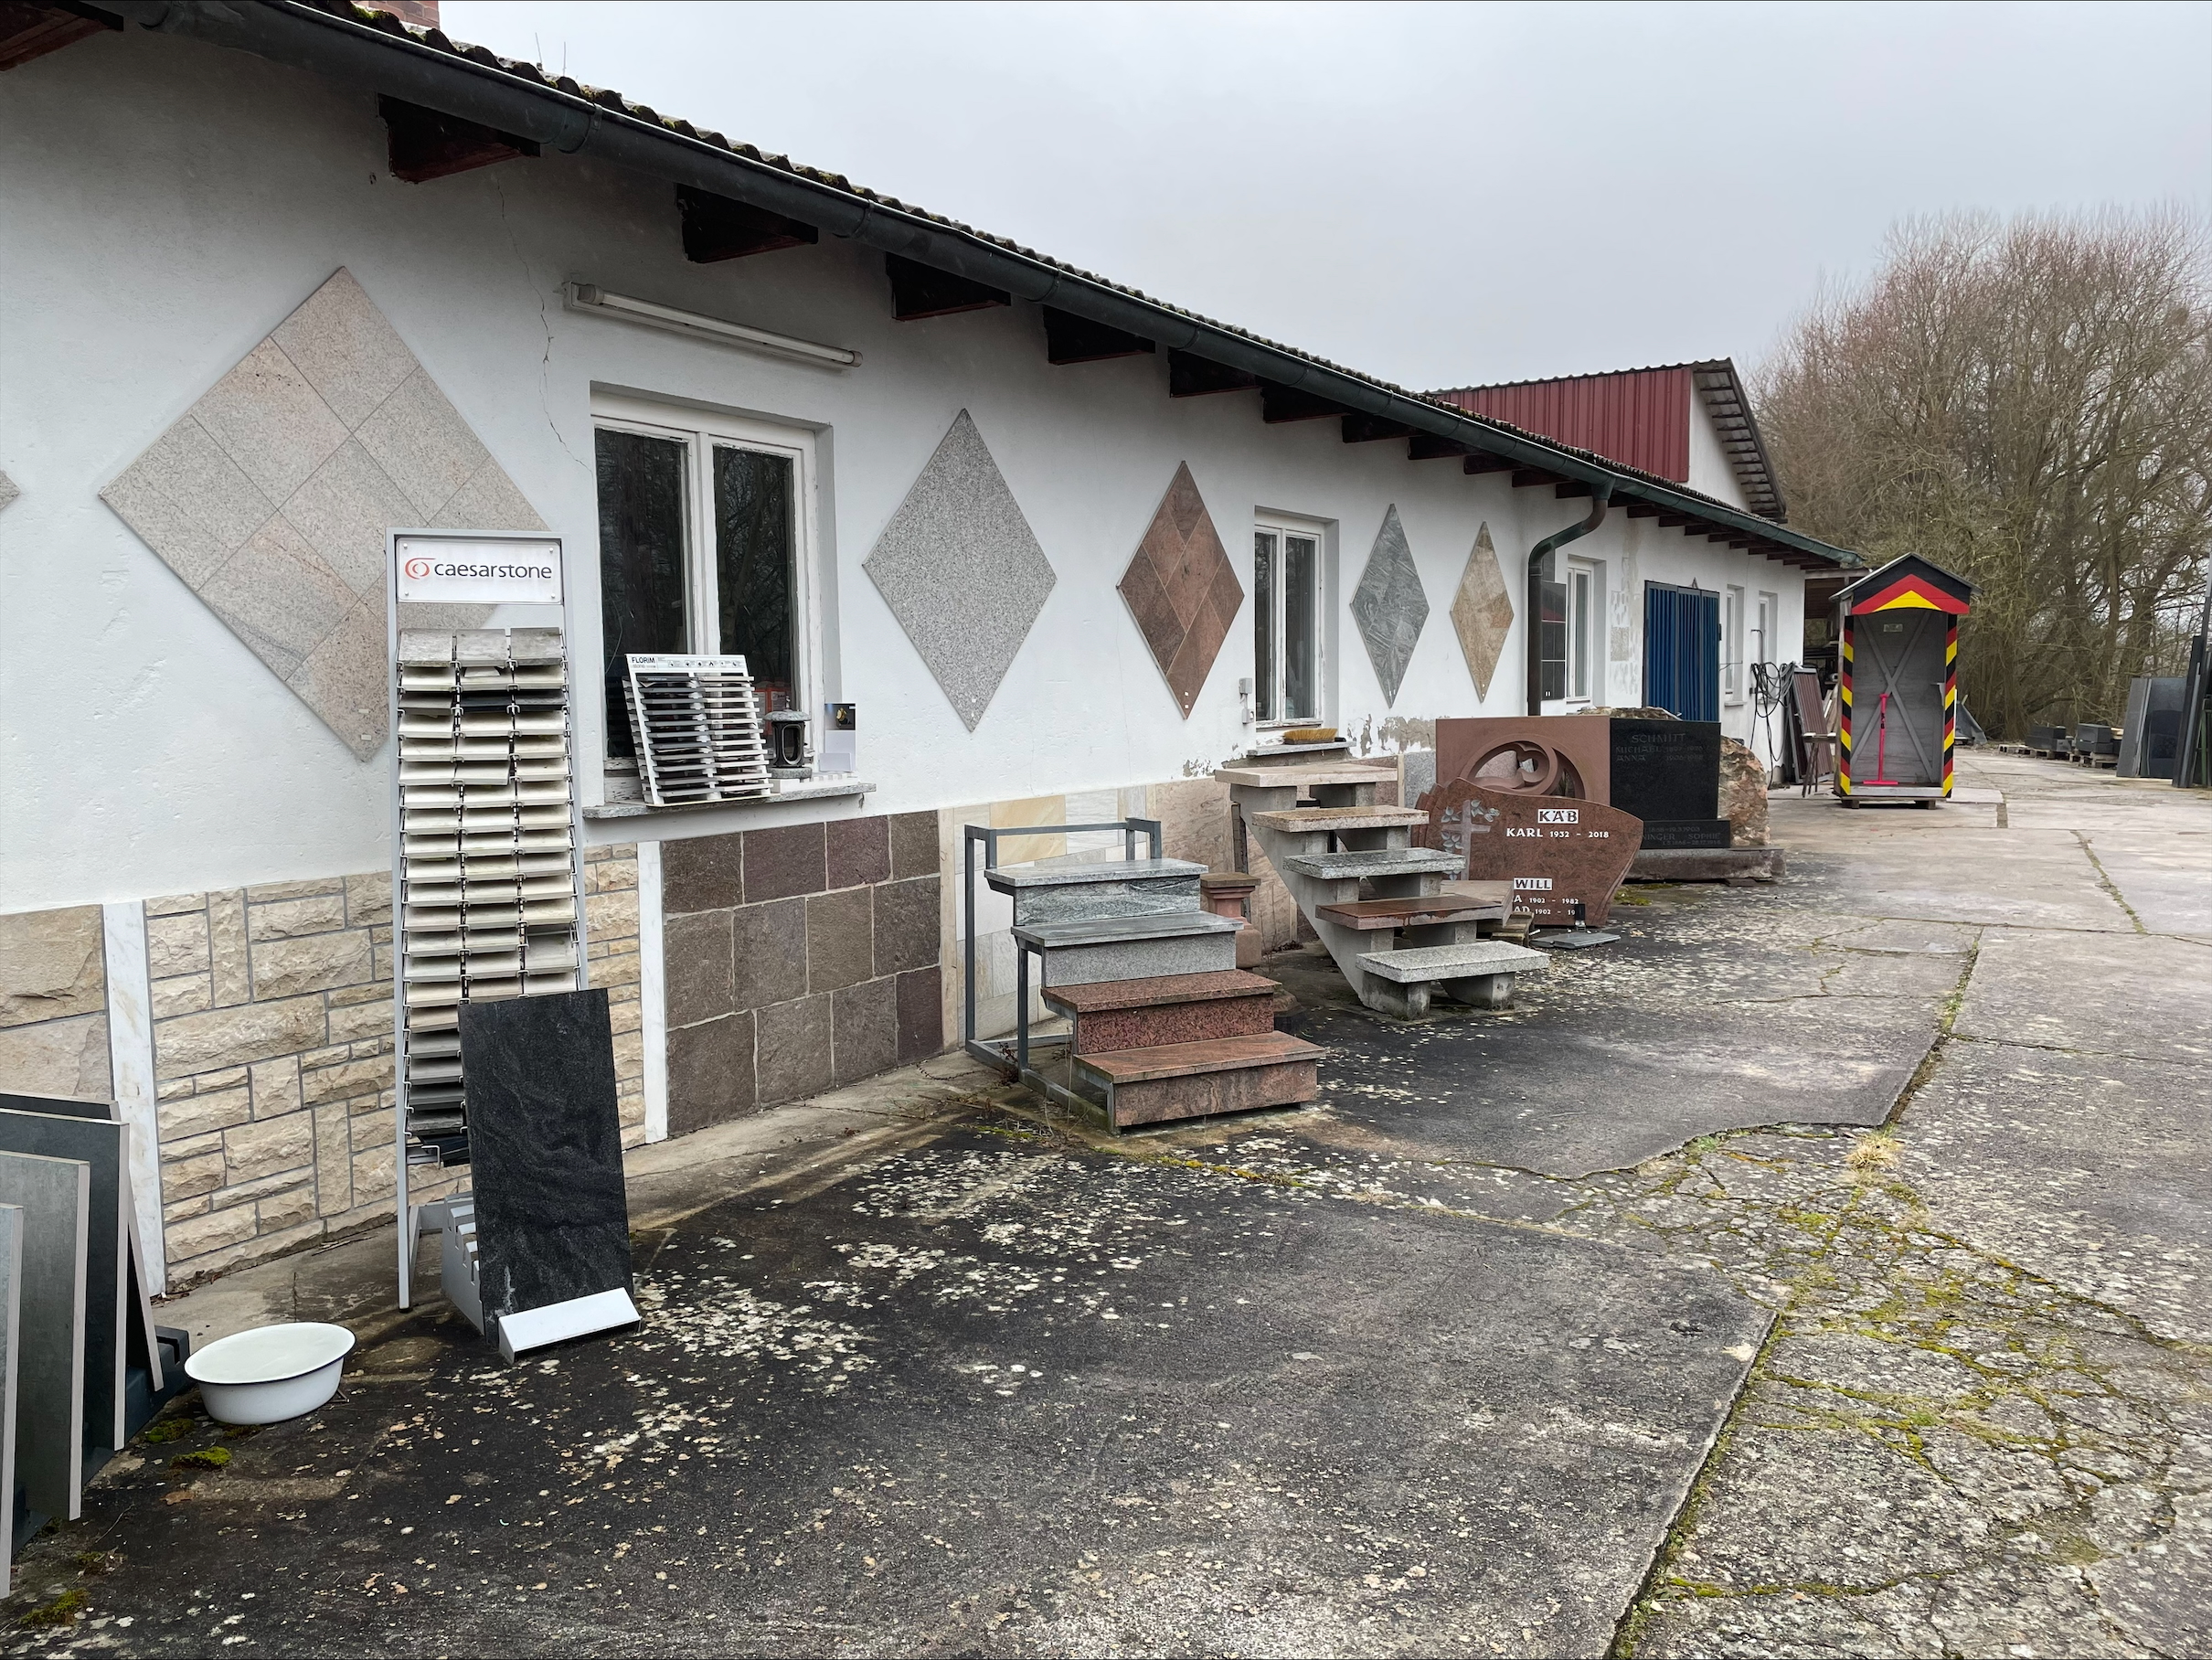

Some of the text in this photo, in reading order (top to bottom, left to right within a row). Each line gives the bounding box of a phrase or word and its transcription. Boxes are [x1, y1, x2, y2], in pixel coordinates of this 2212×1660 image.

[434, 563, 552, 579] caesarstone
[1632, 733, 1686, 743] SCHMITT
[1615, 745, 1661, 753] MICHAEL
[1539, 810, 1578, 823] KÄB
[1506, 828, 1544, 837] KARL
[1549, 830, 1570, 838] 1932
[1688, 832, 1721, 840] SOPHIE
[1515, 879, 1551, 889] WILL
[1514, 895, 1522, 903] A
